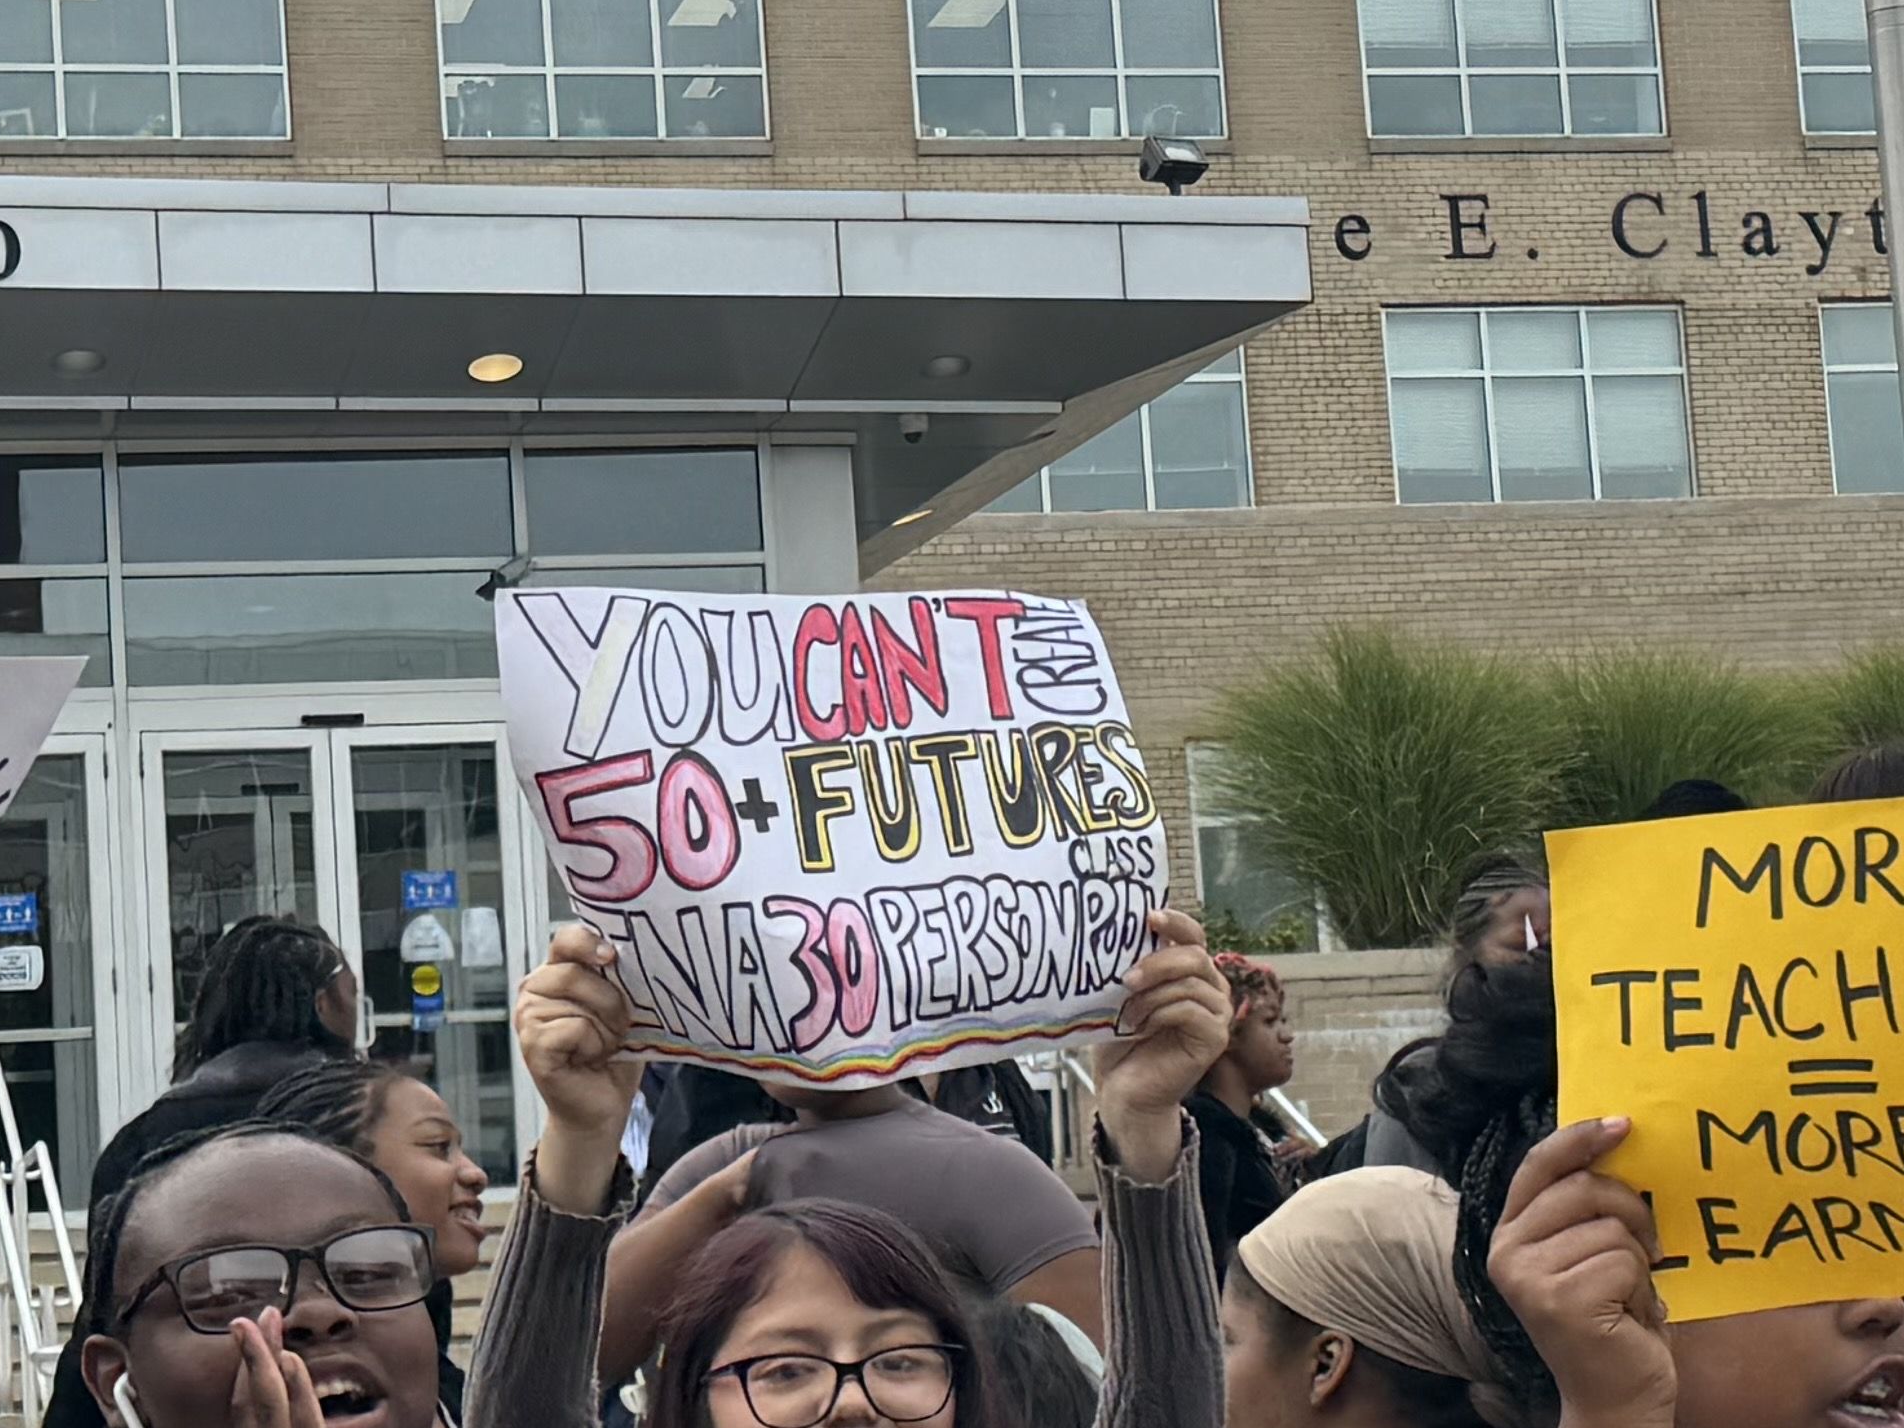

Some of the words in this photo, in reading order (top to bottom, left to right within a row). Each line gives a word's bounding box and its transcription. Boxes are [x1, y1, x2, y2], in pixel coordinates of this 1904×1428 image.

[1440, 193, 1540, 261] E.
[514, 593, 792, 760] YOU
[795, 597, 1030, 742] CAN'T
[534, 747, 780, 903] 50+
[783, 719, 1159, 873] FUTURES
[1068, 835, 1156, 879] CLASS
[866, 875, 1079, 1030] PERSON
